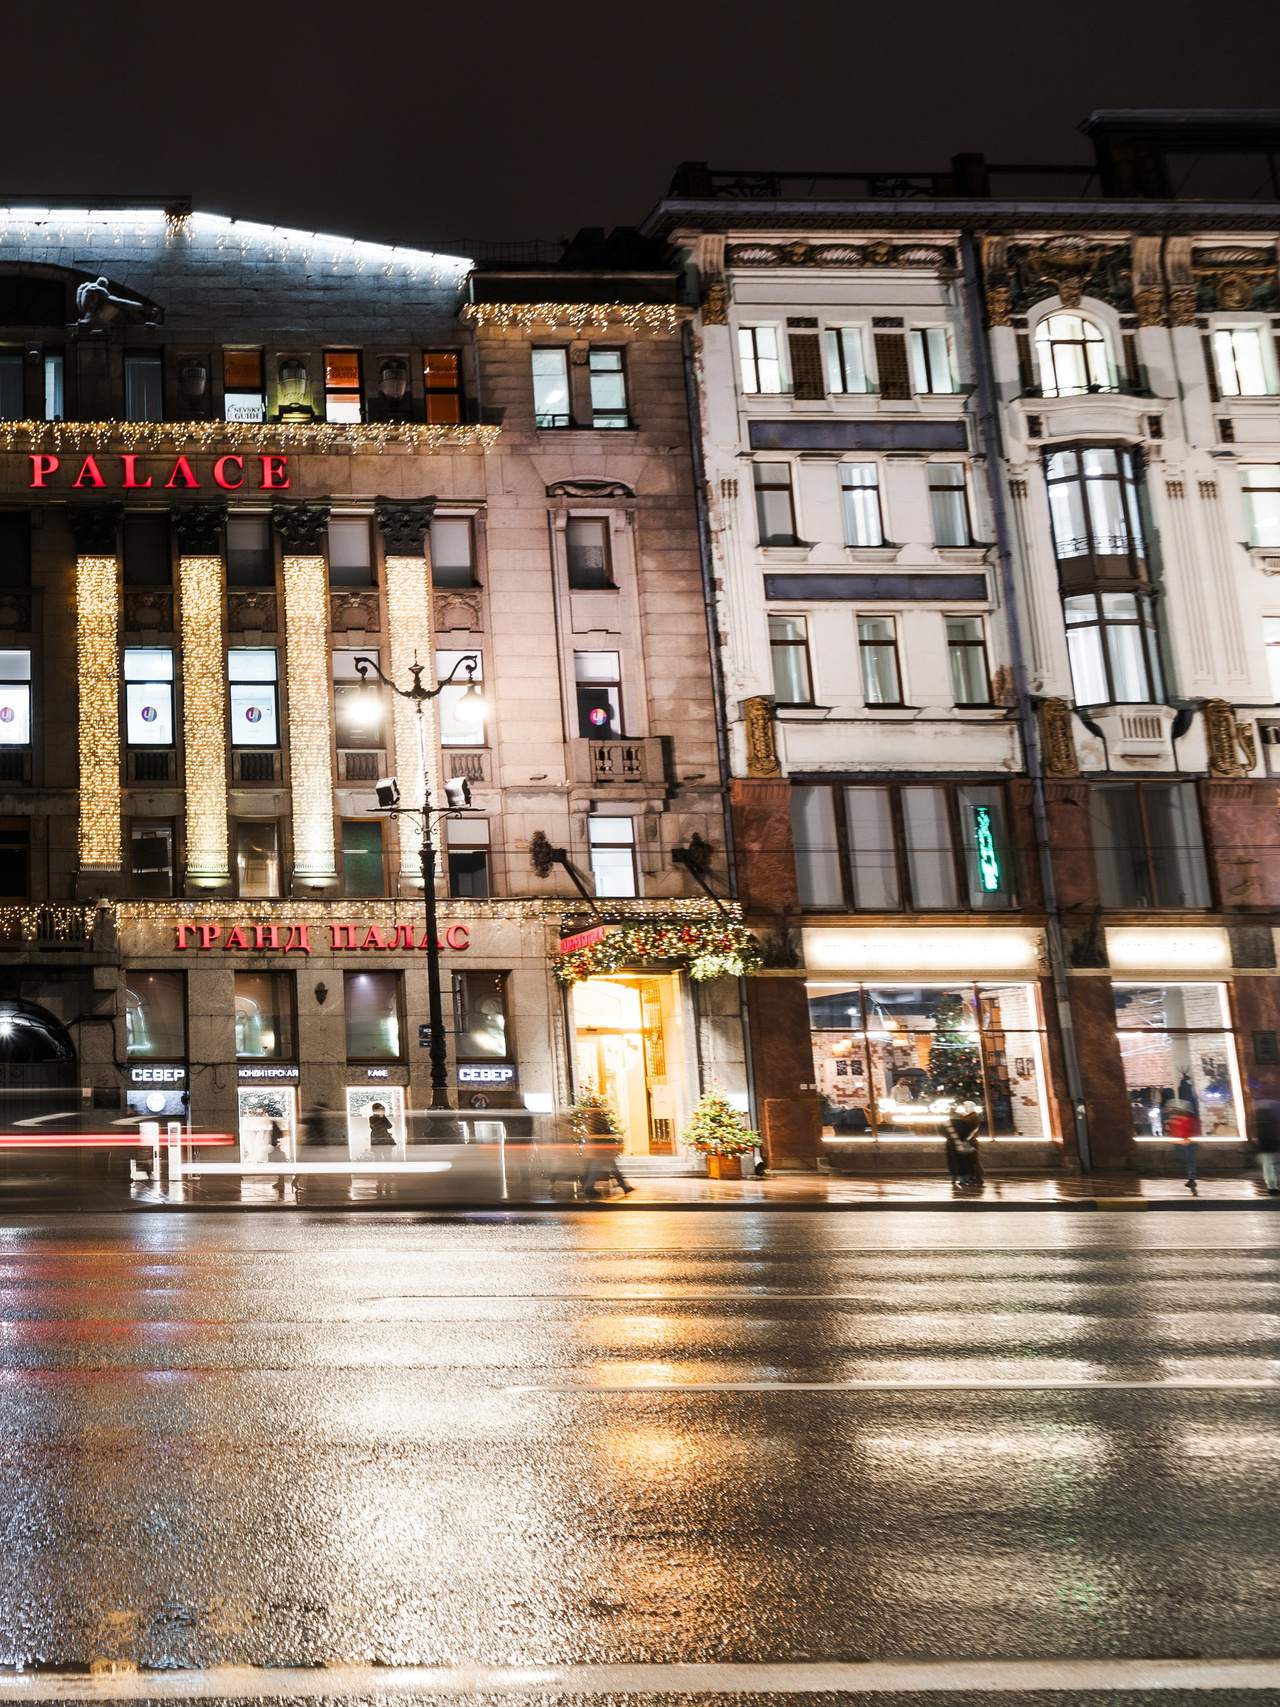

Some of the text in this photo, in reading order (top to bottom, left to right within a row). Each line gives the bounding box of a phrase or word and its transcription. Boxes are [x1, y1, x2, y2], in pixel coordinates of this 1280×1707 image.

[28, 453, 291, 490] PALACE
[175, 924, 311, 954] ГРАНД
[131, 1068, 185, 1082] СЕВЕР
[238, 1069, 299, 1078] КОНДИТЕРСКАЯ
[367, 1069, 389, 1078] КАФЕ
[458, 1068, 513, 1082] СЕВЕР
